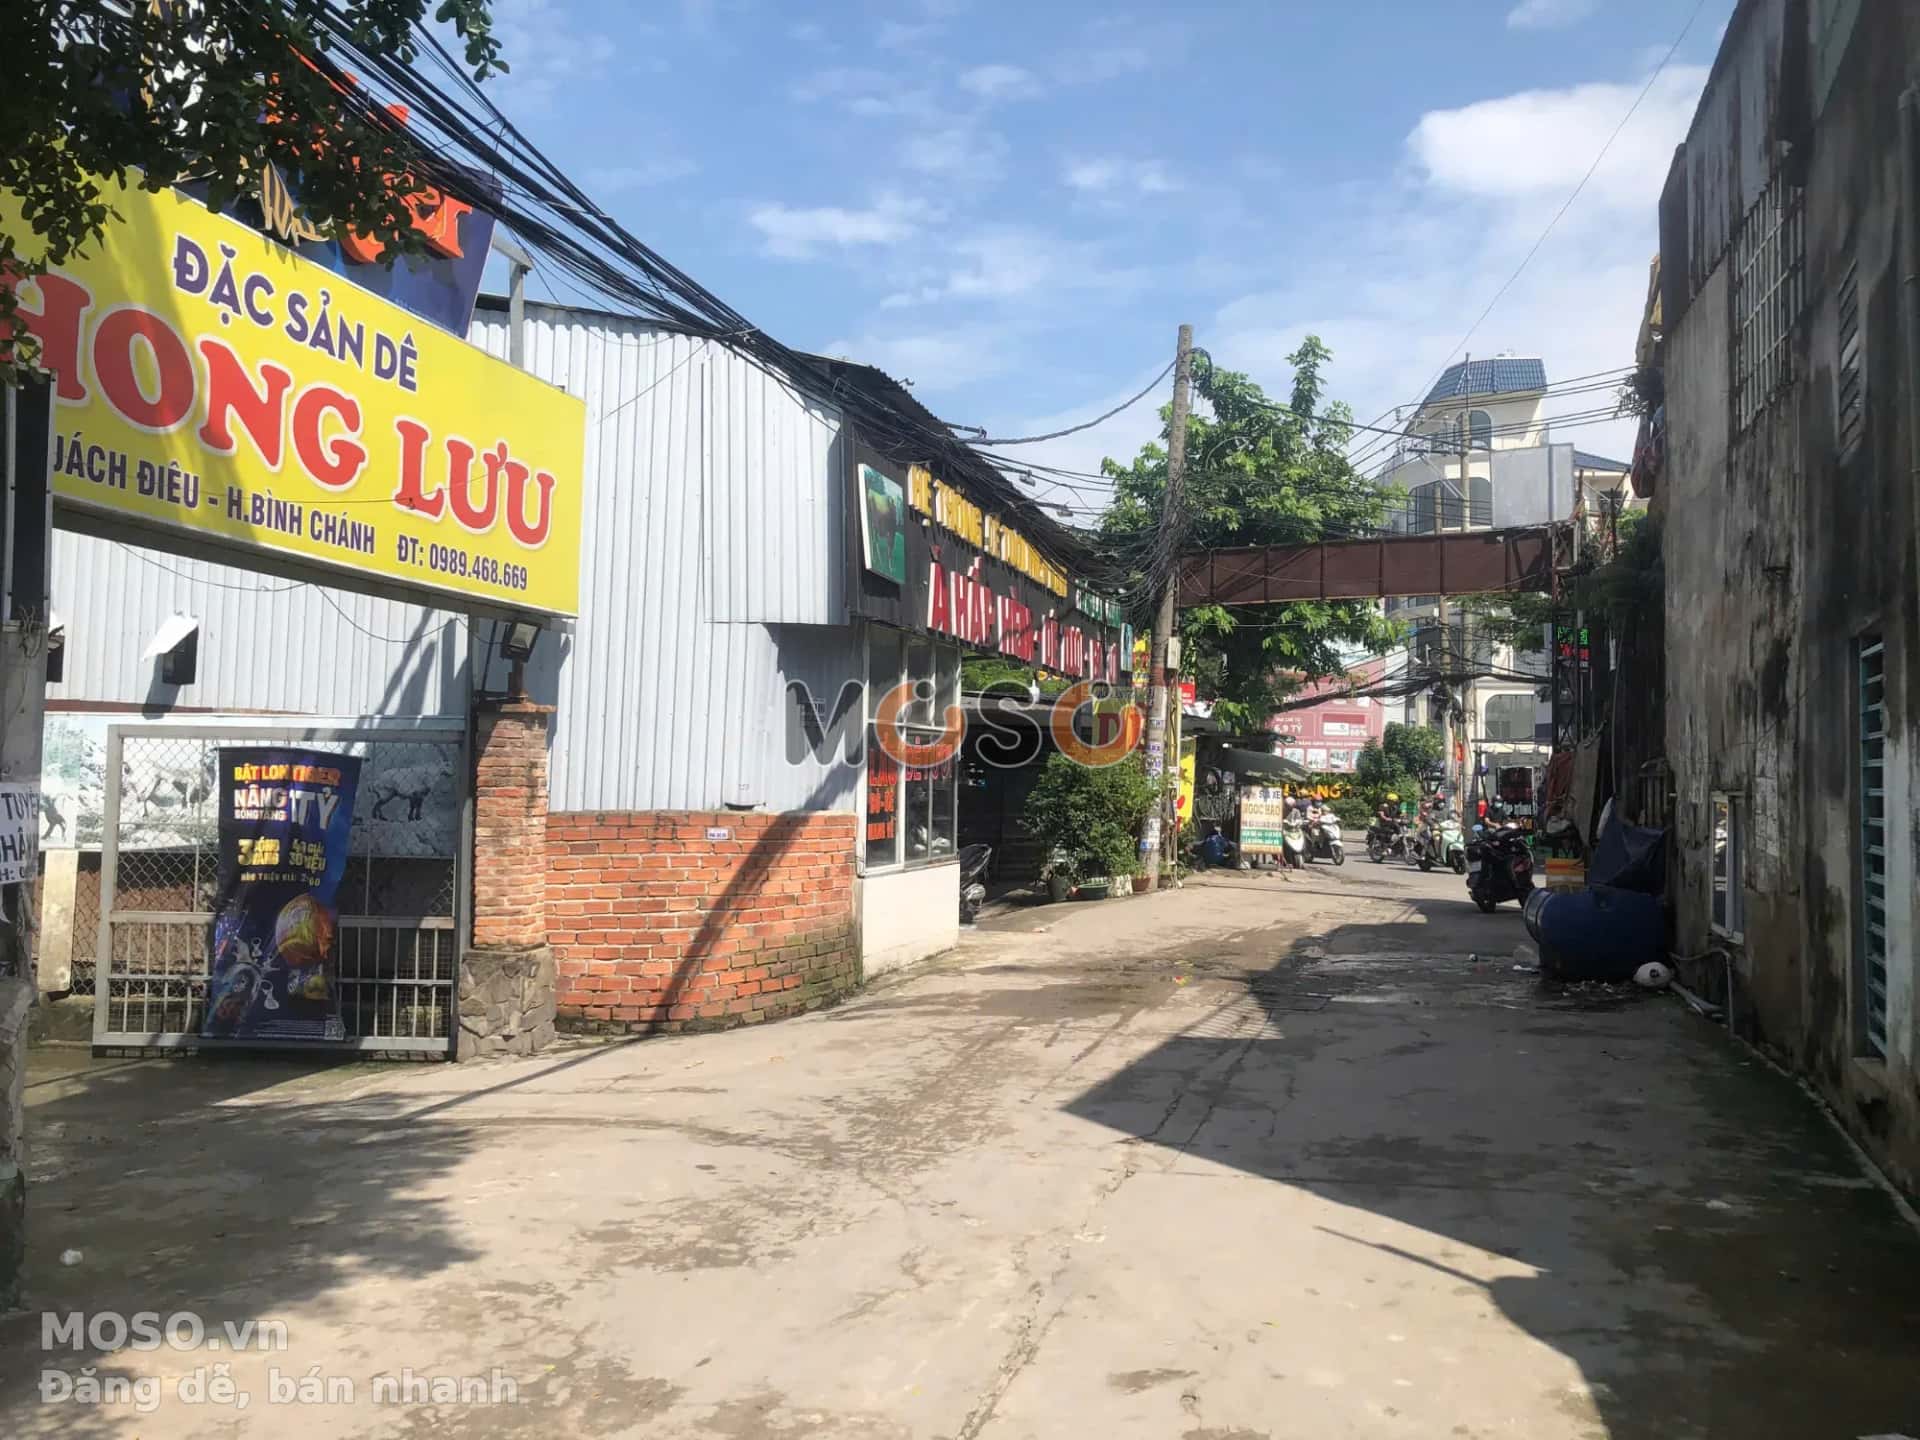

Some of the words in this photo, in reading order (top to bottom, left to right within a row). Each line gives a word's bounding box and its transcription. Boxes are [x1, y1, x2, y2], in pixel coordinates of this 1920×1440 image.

[173, 234, 275, 326] ĐẶC
[284, 289, 366, 369] SẢN
[374, 333, 419, 392] DÊ
[136, 460, 200, 510] ĐIÊU
[227, 485, 303, 539] H.BÌNH
[310, 510, 376, 555] CHÁNH
[396, 533, 425, 568] ĐT:
[429, 543, 528, 591] 0989.468.669
[394, 419, 556, 546] LƯU
